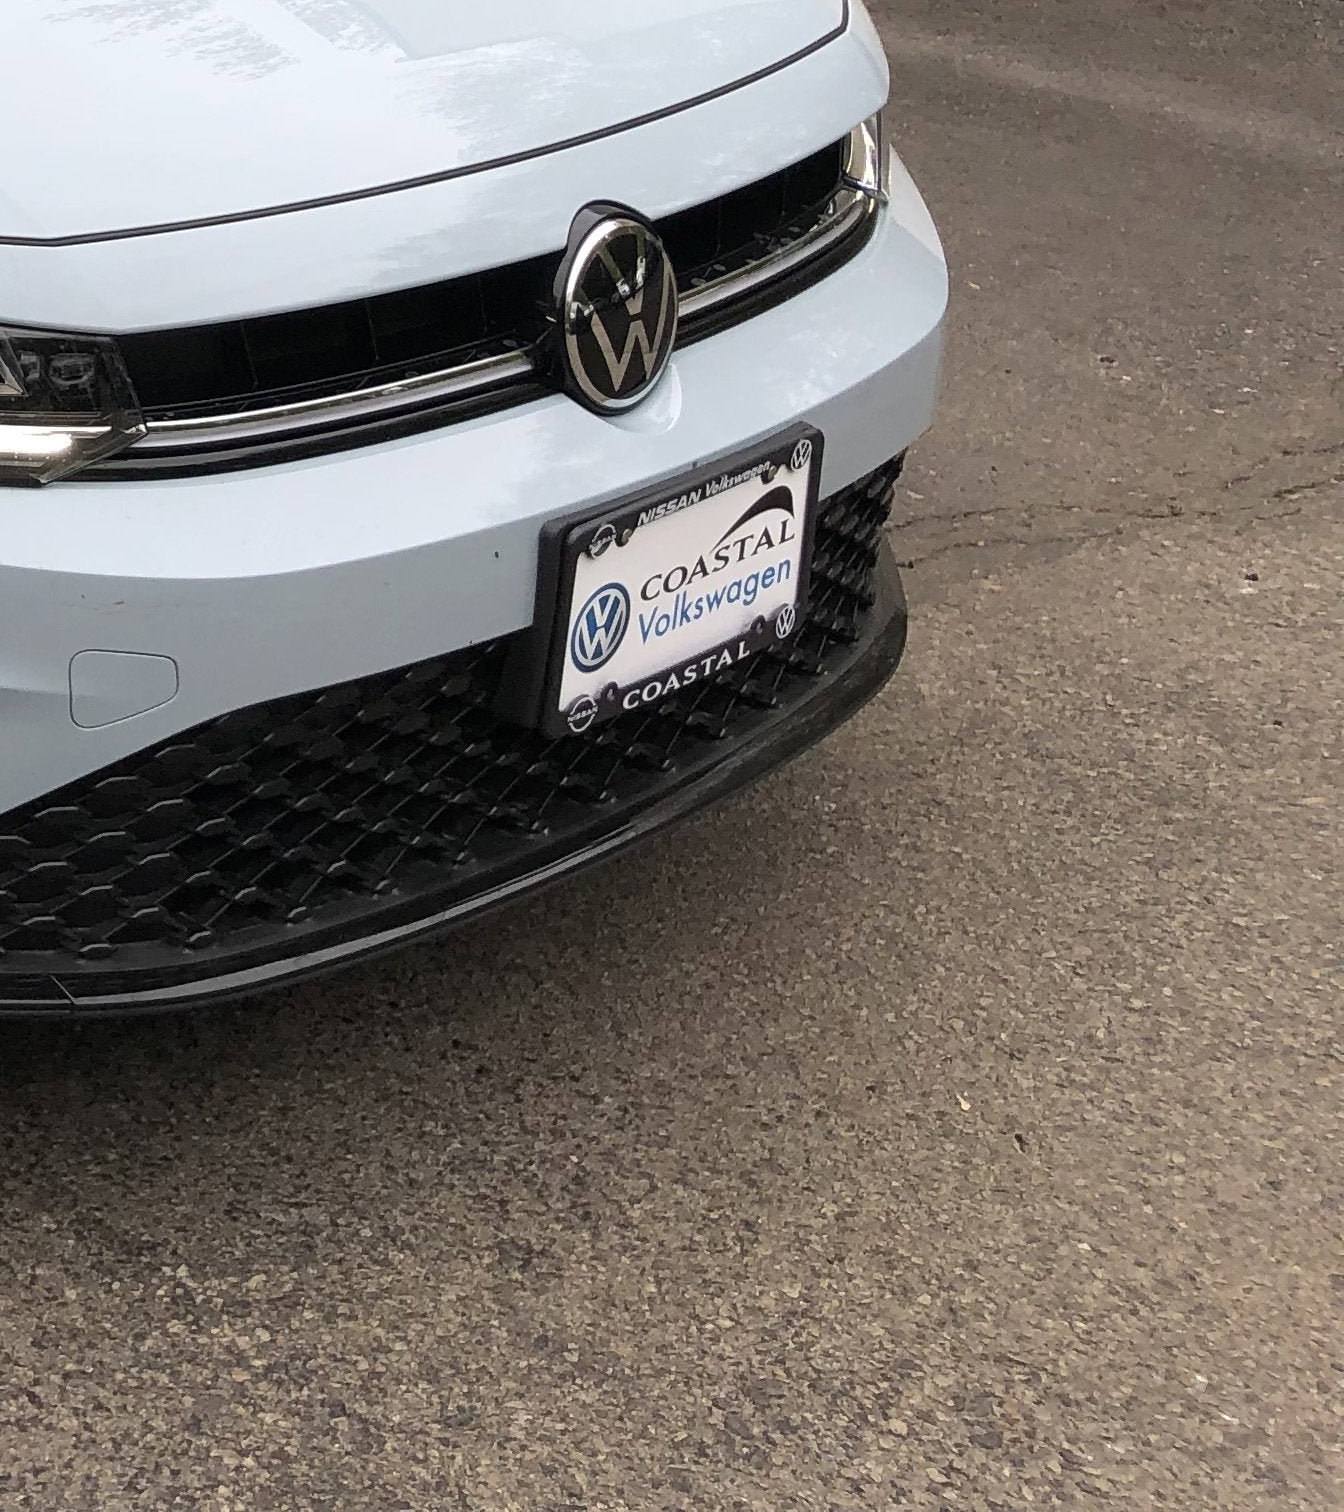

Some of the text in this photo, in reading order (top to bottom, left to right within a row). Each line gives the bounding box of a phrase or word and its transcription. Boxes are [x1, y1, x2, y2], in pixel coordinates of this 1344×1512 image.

[637, 461, 771, 526] NISSAN Volkswagen
[640, 519, 796, 601] COASTAL
[639, 559, 791, 644] Volkswagen
[622, 640, 751, 710] COASTAL
